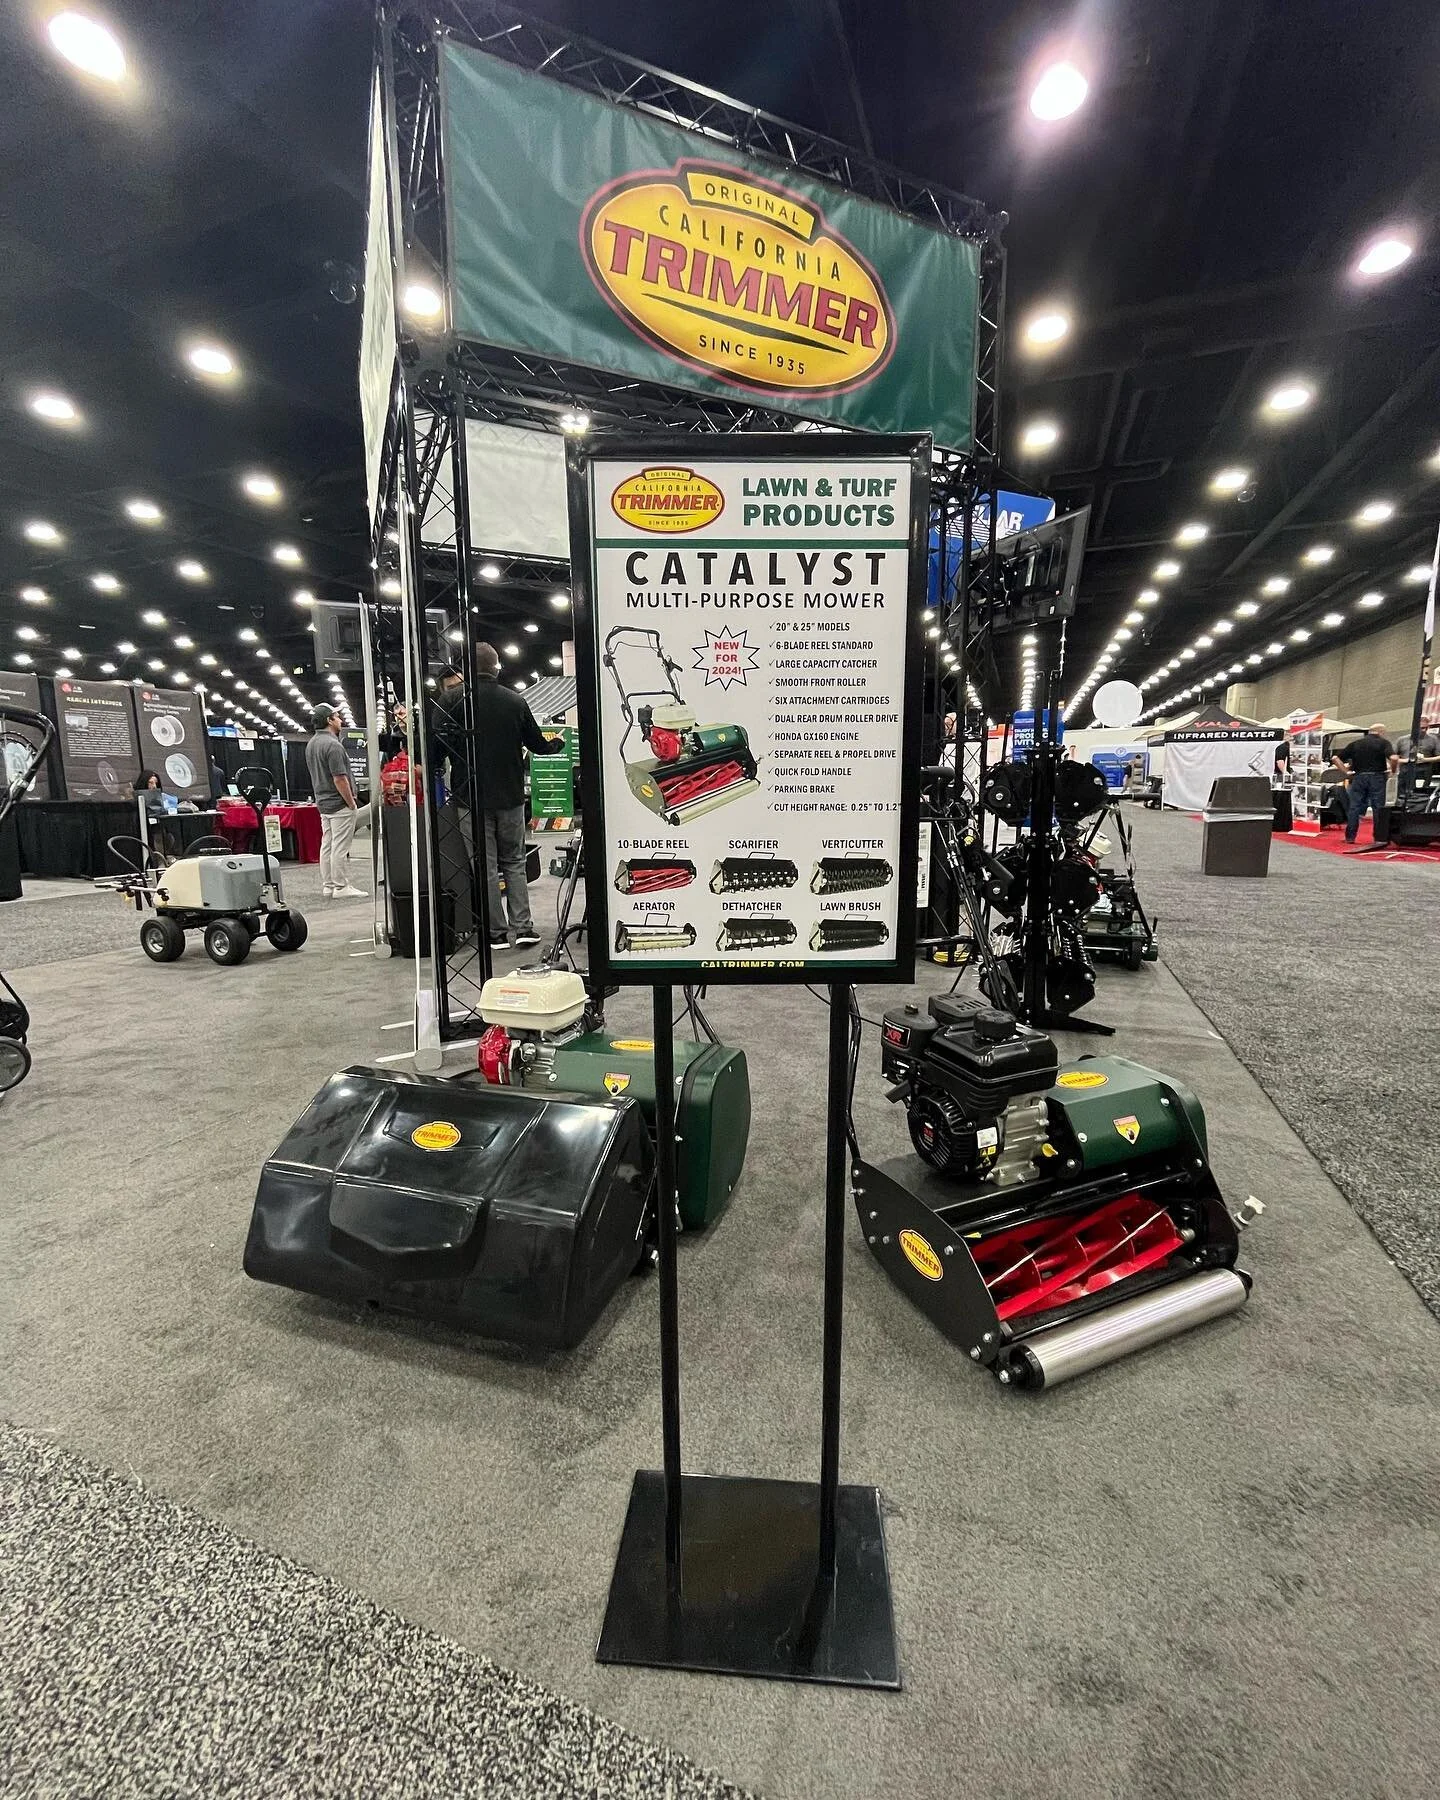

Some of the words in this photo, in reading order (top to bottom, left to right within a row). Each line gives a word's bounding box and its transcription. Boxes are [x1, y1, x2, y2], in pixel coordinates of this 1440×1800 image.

[705, 182, 799, 225] ORIGINAL
[659, 205, 840, 281] CALIFORNIA
[604, 219, 878, 349] TRIMMER
[699, 335, 756, 360] SINCE
[767, 352, 806, 375] 1935
[635, 484, 702, 492] CALIFORNIA
[742, 478, 808, 497] LAWN
[815, 477, 833, 497] &
[839, 478, 897, 497] TURF
[617, 494, 718, 510] TRIMMER
[743, 504, 895, 526] PRODUCTS
[625, 551, 886, 586] CATALYST
[626, 592, 794, 608] MULTI-PURPOSE
[803, 592, 885, 609] MOWER
[776, 623, 790, 631] 20"
[792, 623, 799, 631] &
[800, 623, 815, 631] 25"
[817, 623, 850, 631] MODELS
[714, 641, 739, 650] NEW
[776, 641, 809, 650] 6-BLADE
[811, 641, 830, 650] REEL
[831, 641, 873, 650] STANDARD
[715, 654, 738, 662] FOR
[775, 660, 801, 668] LARGE
[802, 660, 840, 668] CAPACITY
[841, 660, 878, 668] CATCHER
[712, 666, 742, 675] 2024!
[775, 678, 809, 687] SMOOTH
[810, 678, 836, 687] FRONT
[837, 678, 867, 687] ROLLER
[775, 696, 788, 705] SIX
[789, 696, 840, 705] ATTACHMENT
[841, 696, 890, 705] CARTRIDGES
[774, 714, 796, 723] DUAL
[797, 714, 817, 723] REAR
[819, 714, 843, 723] DRUM
[844, 714, 874, 723] ROLLER
[875, 714, 899, 723] DRIVE
[774, 732, 802, 741] HONDA
[803, 732, 829, 741] GX160
[830, 732, 859, 741] ENGINE
[1173, 731, 1229, 740] INFRARED
[774, 750, 812, 759] SEPARATE
[814, 750, 833, 759] REEL
[834, 750, 841, 759] &
[842, 750, 872, 759] PROPEL
[873, 750, 897, 759] DRIVE
[774, 768, 799, 777] QUICK
[800, 768, 820, 776] FOLD
[821, 768, 852, 776] HANDLE
[774, 785, 808, 794] PARKING
[809, 785, 835, 793] BRAKE
[774, 803, 789, 812] CUT
[790, 803, 818, 812] HEIGHT
[819, 803, 847, 812] RANGE:
[850, 803, 873, 812] 0.25"
[874, 803, 883, 812] TO
[617, 839, 664, 849] 10-BLADE
[665, 839, 690, 849] REEL
[728, 839, 779, 849] SCARIFIER
[822, 839, 884, 849] VERTICUTTER
[632, 902, 676, 911] AERATOR
[722, 902, 782, 911] DETHATCHER
[820, 902, 846, 911] LAWN
[848, 902, 881, 911] BRUSH
[700, 960, 805, 968] CALTRIMMERCOM
[415, 1130, 457, 1142] TRIMMER
[901, 1236, 940, 1275] TRIMMER
